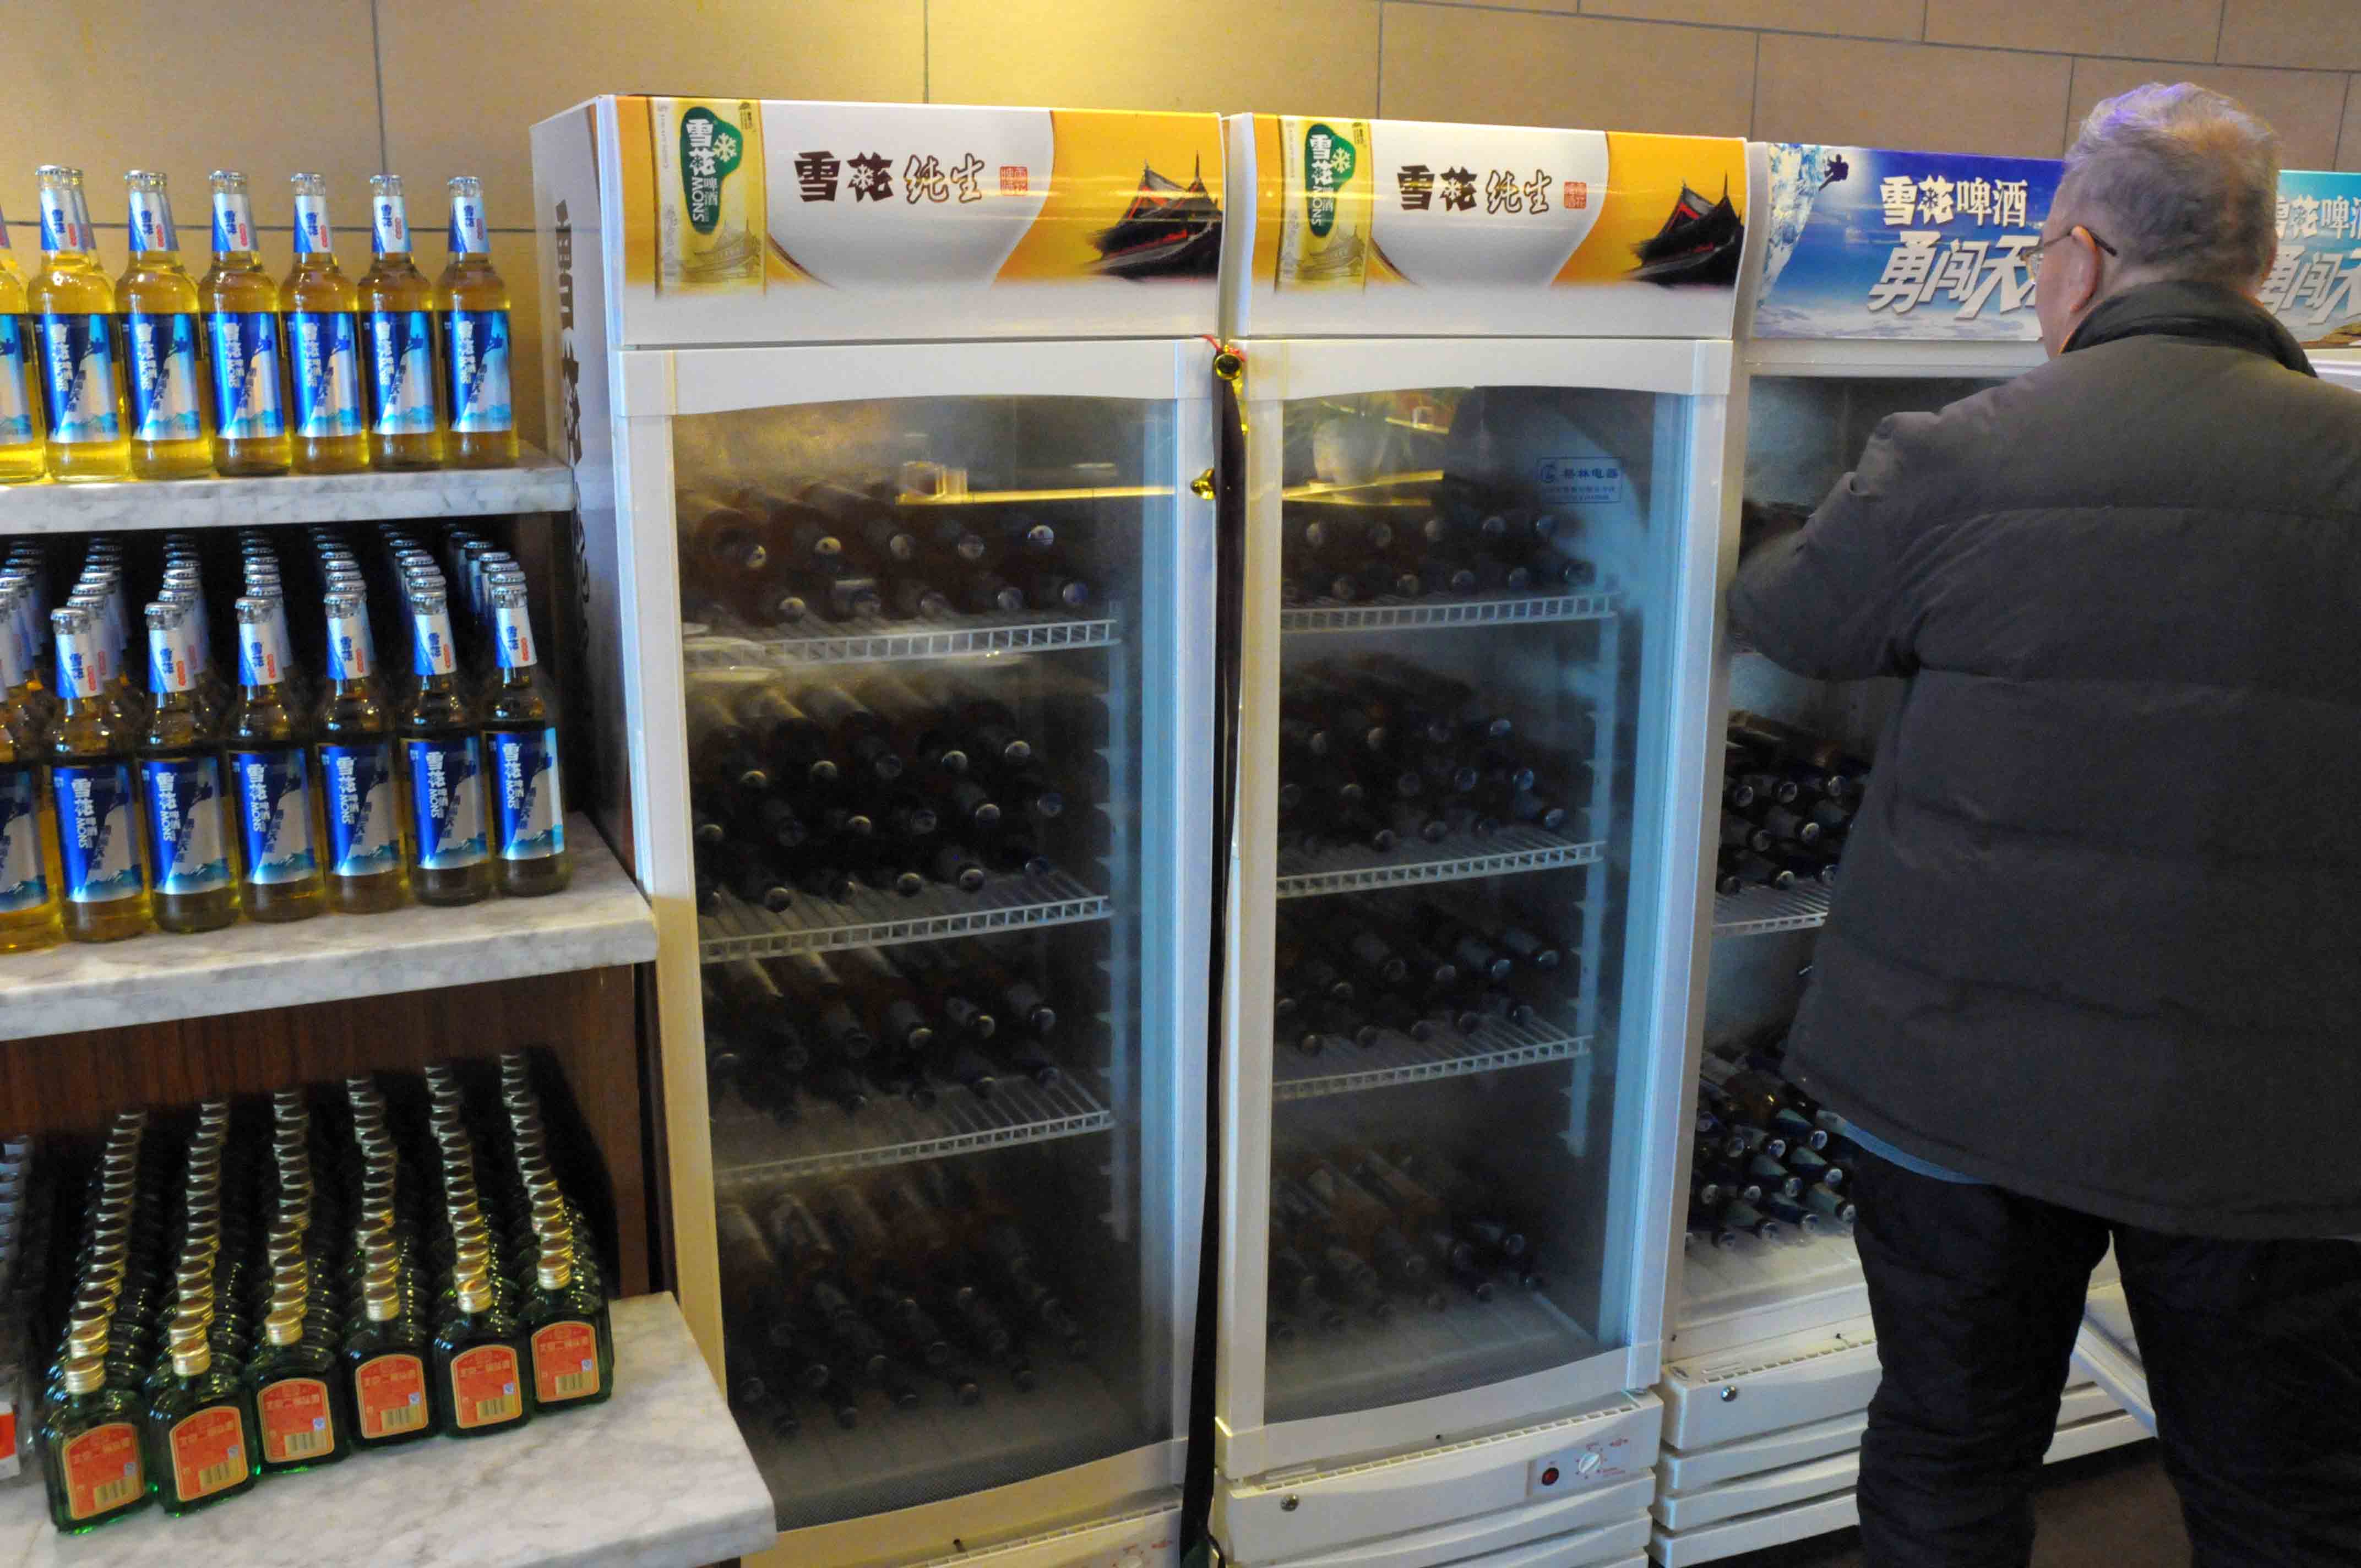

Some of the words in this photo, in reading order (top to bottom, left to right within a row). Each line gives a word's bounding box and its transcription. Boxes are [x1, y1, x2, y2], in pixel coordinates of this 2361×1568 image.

[686, 118, 716, 176] 雪花
[794, 151, 985, 204] 雪花纯生
[1397, 165, 1552, 214] 雪花纯生
[1880, 175, 2028, 227] 雪花啤酒
[1867, 231, 2040, 319] 勇闯天
